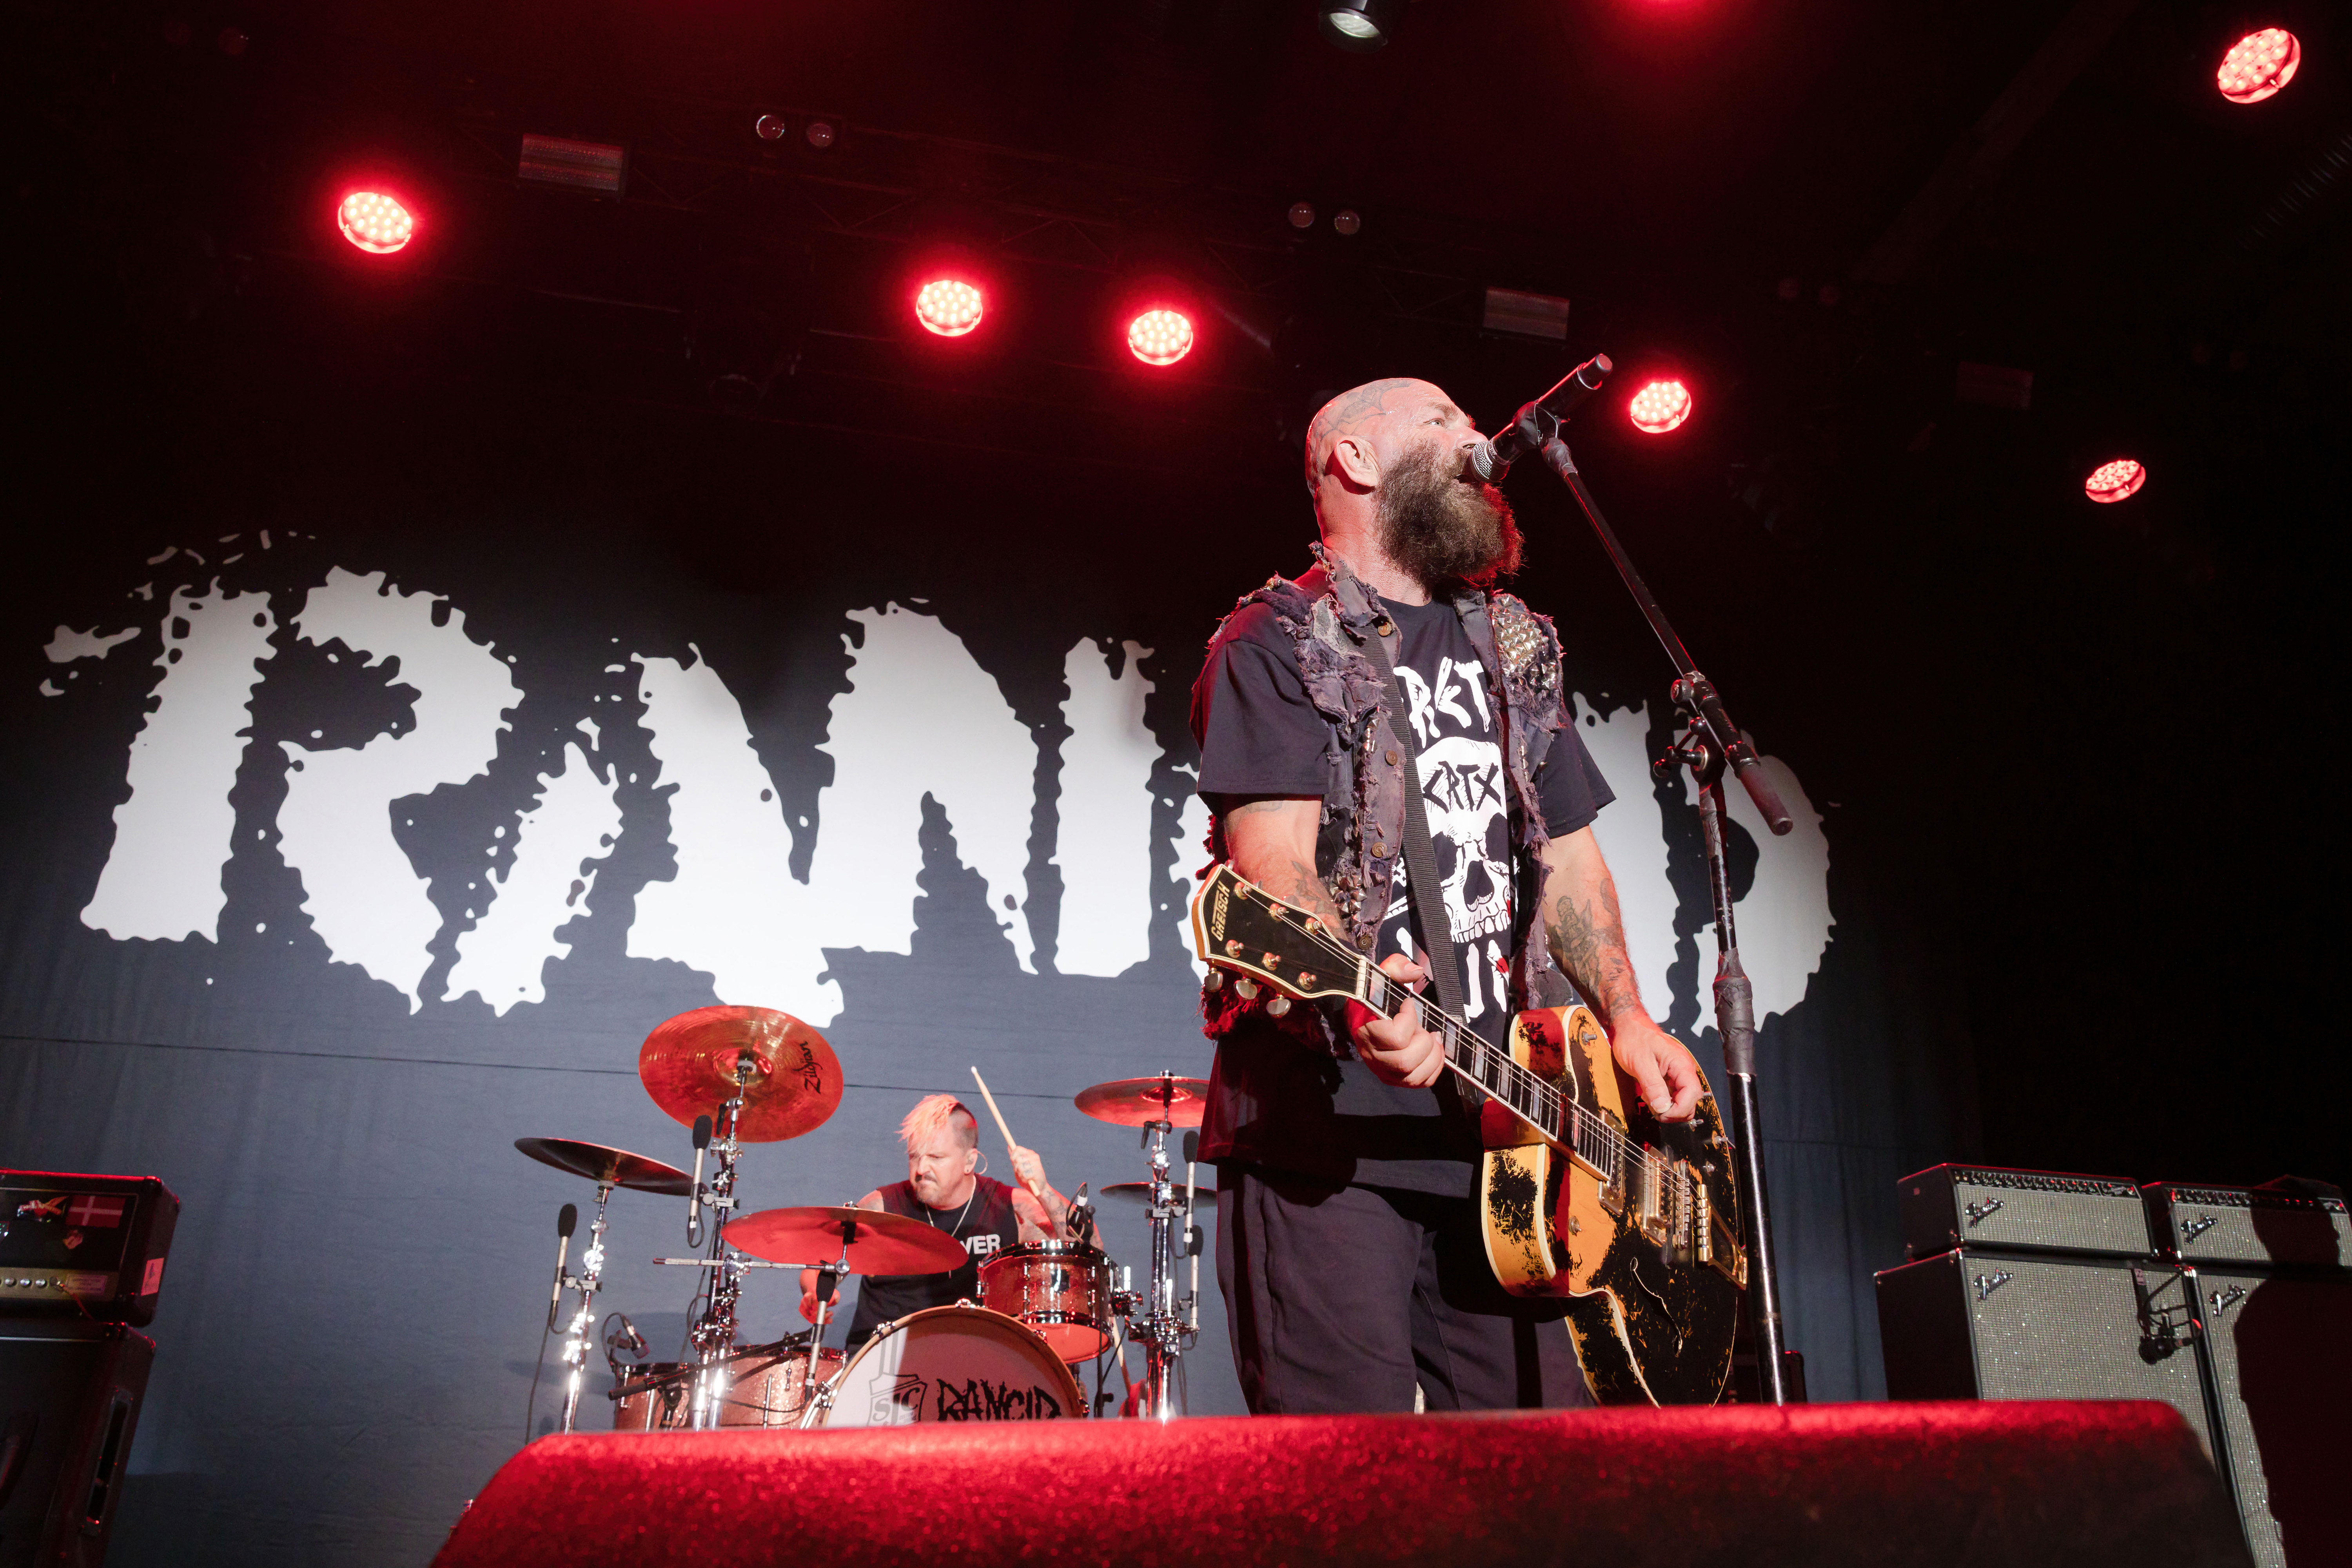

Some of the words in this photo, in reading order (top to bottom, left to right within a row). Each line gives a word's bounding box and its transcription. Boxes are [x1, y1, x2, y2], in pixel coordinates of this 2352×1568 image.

[1393, 656, 1491, 749] RKT
[42, 539, 1842, 1037] RANID
[1423, 760, 1502, 814] CRTX
[1211, 880, 1230, 942] GRETSCH
[792, 1041, 823, 1094] Zildjian
[959, 1234, 1001, 1255] VER
[872, 1387, 920, 1426] SJC
[936, 1378, 1062, 1421] RANCID
